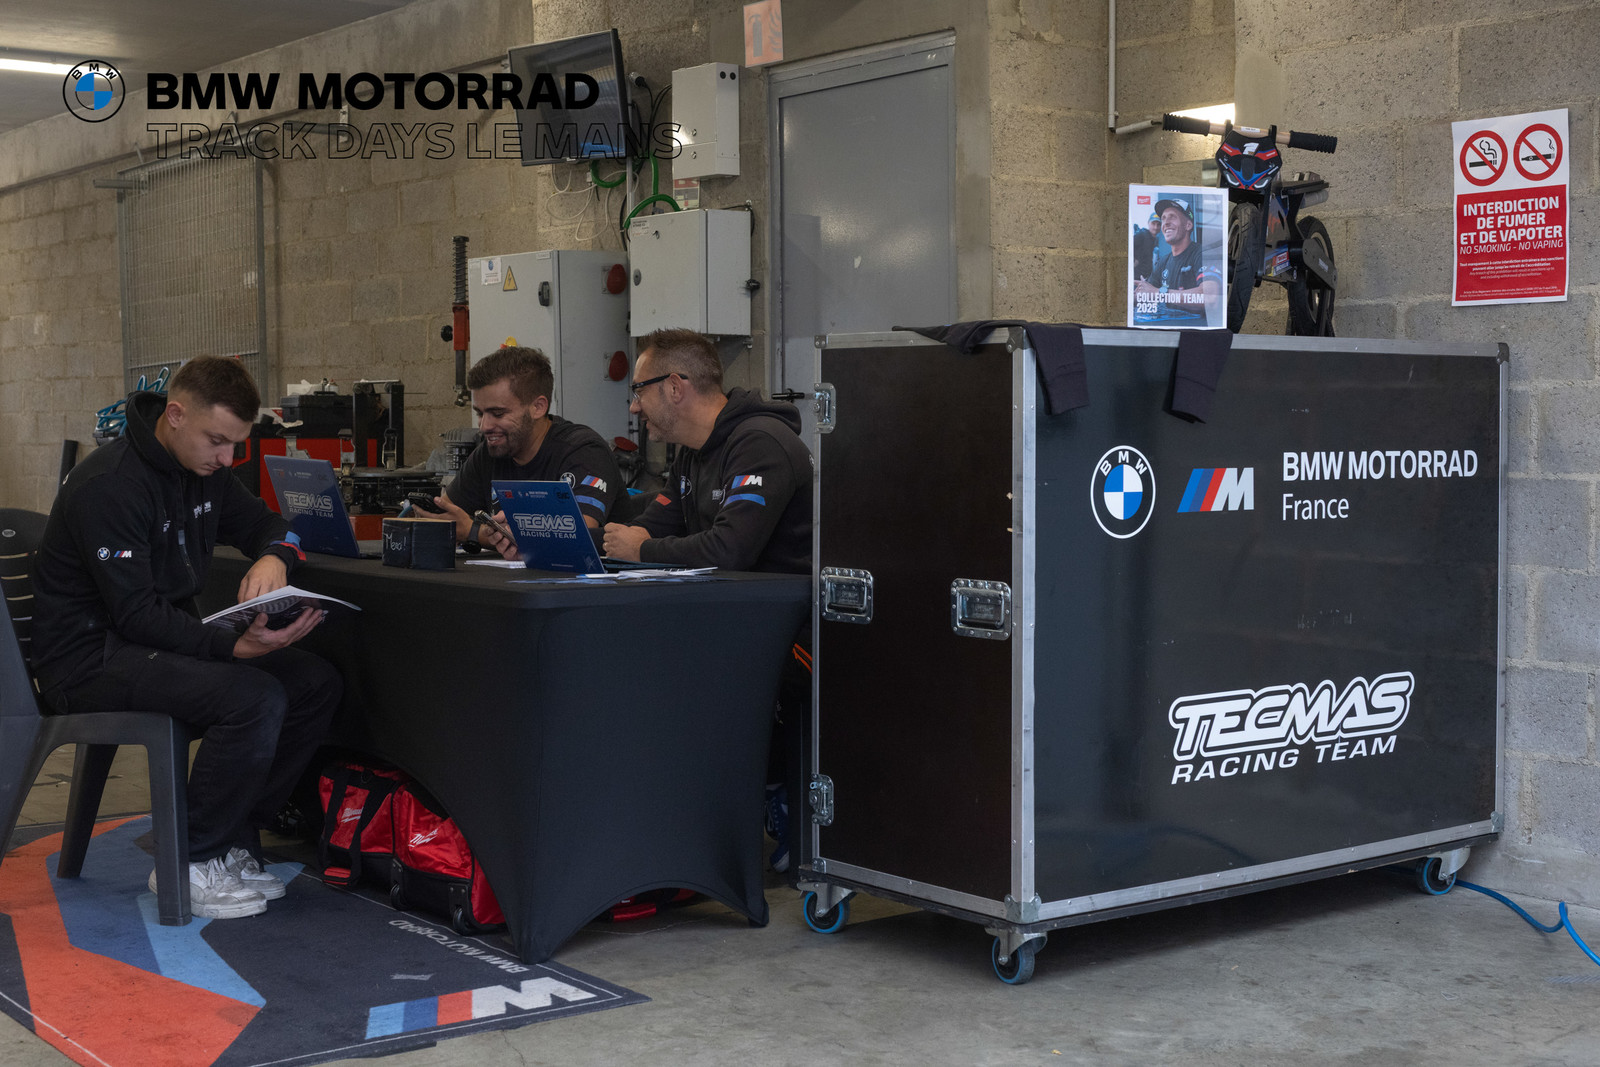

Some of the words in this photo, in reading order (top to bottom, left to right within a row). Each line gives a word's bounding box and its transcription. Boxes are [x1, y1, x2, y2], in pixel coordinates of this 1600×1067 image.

[1463, 196, 1559, 217] INTERDICTION
[1476, 216, 1495, 230] DE
[1497, 212, 1546, 228] FUMER
[1460, 232, 1477, 245] ET
[1479, 230, 1497, 244] DE
[1499, 225, 1563, 242] VAPOTER
[1460, 246, 1472, 255] NO
[1473, 243, 1512, 254] SMOKING
[1518, 242, 1531, 251] NO
[1532, 238, 1564, 250] VAPING
[1136, 292, 1181, 303] COLLECTION
[1182, 293, 1205, 304] TEAM
[1136, 302, 1158, 313] 2025
[1099, 450, 1147, 476] BMW
[1283, 451, 1343, 481] BMW
[1348, 450, 1478, 480] MOTORRAD
[284, 491, 334, 512] TECMAS
[1283, 493, 1349, 520] France
[513, 513, 577, 533] TECMAS
[520, 530, 551, 538] RACING
[1168, 671, 1415, 761] TECMAS
[1171, 749, 1300, 785] RACING
[1315, 735, 1398, 763] TEAM
